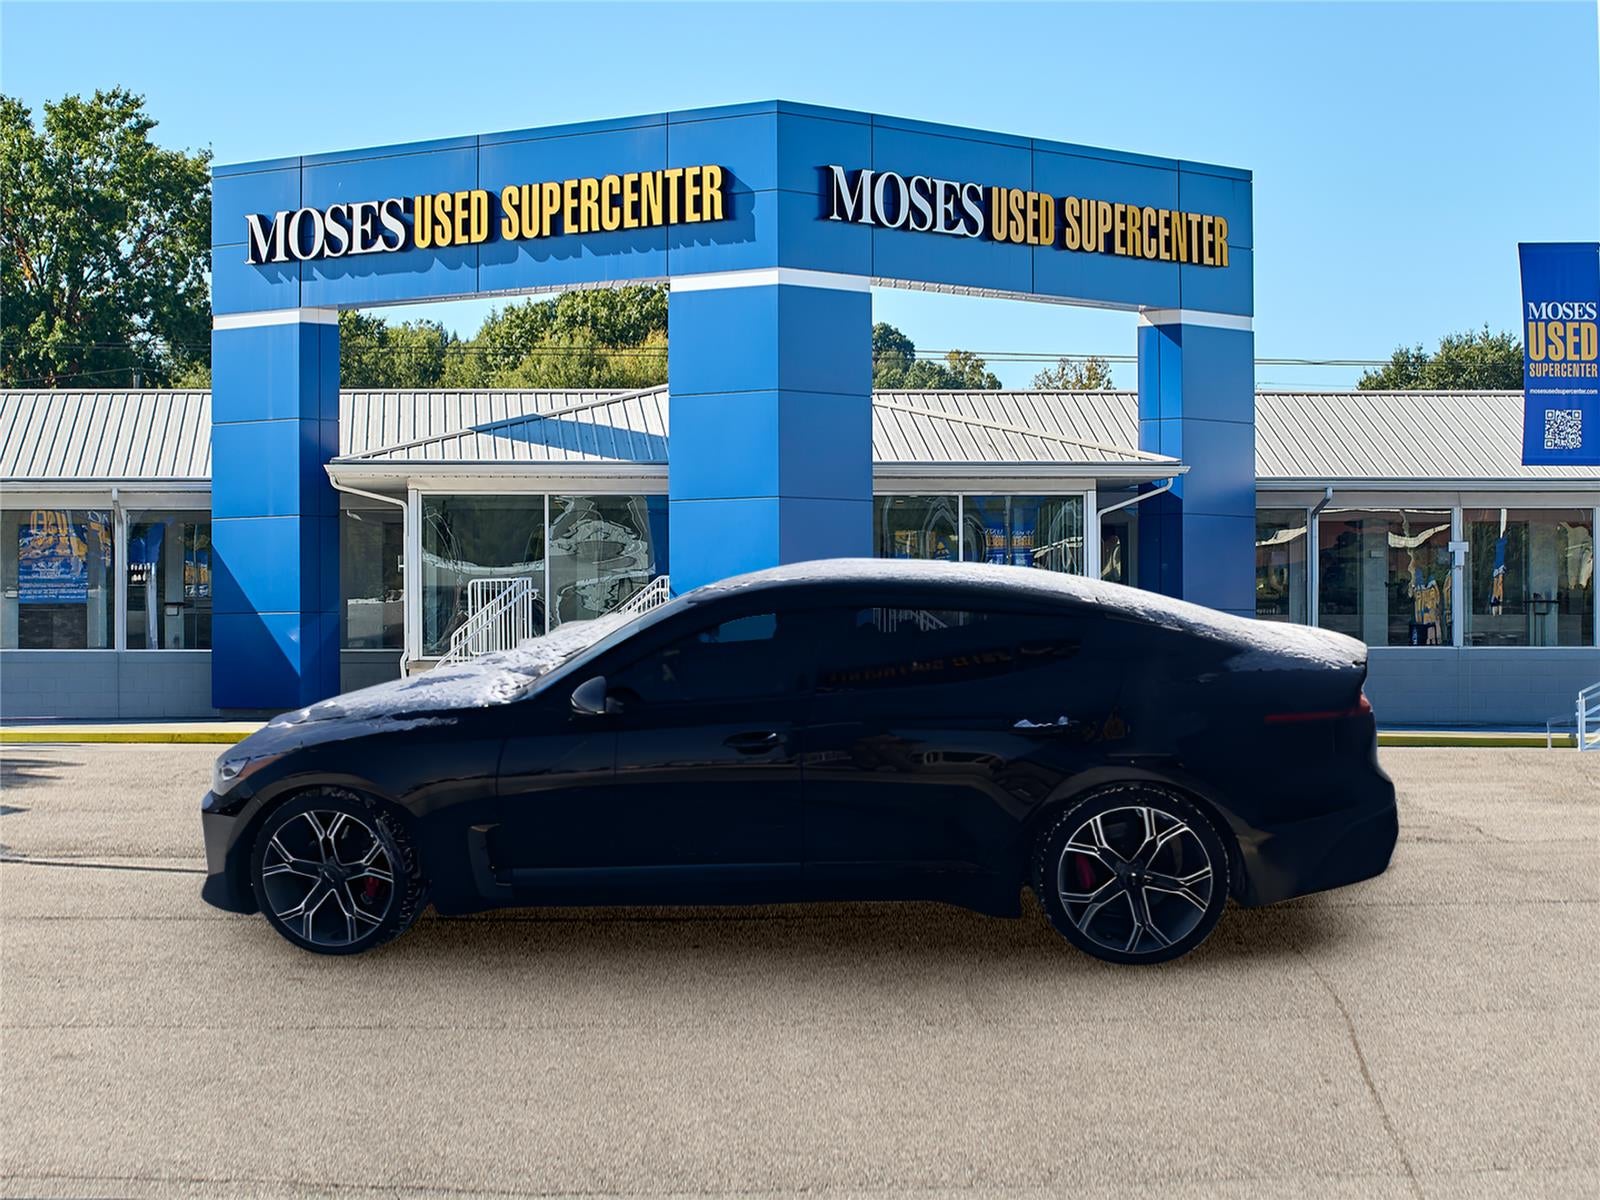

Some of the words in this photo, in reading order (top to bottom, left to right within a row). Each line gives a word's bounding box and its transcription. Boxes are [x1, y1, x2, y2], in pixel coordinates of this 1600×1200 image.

[244, 198, 406, 265] MOSES
[412, 189, 488, 249] USED
[500, 164, 724, 241] SUPERCENTER
[828, 164, 985, 238] MOSES
[991, 186, 1056, 246] USED
[1064, 196, 1230, 267] SUPERCENTER
[1528, 302, 1597, 320] MOSES
[1528, 322, 1598, 361] USED
[1529, 363, 1598, 377] SUPERCENTER
